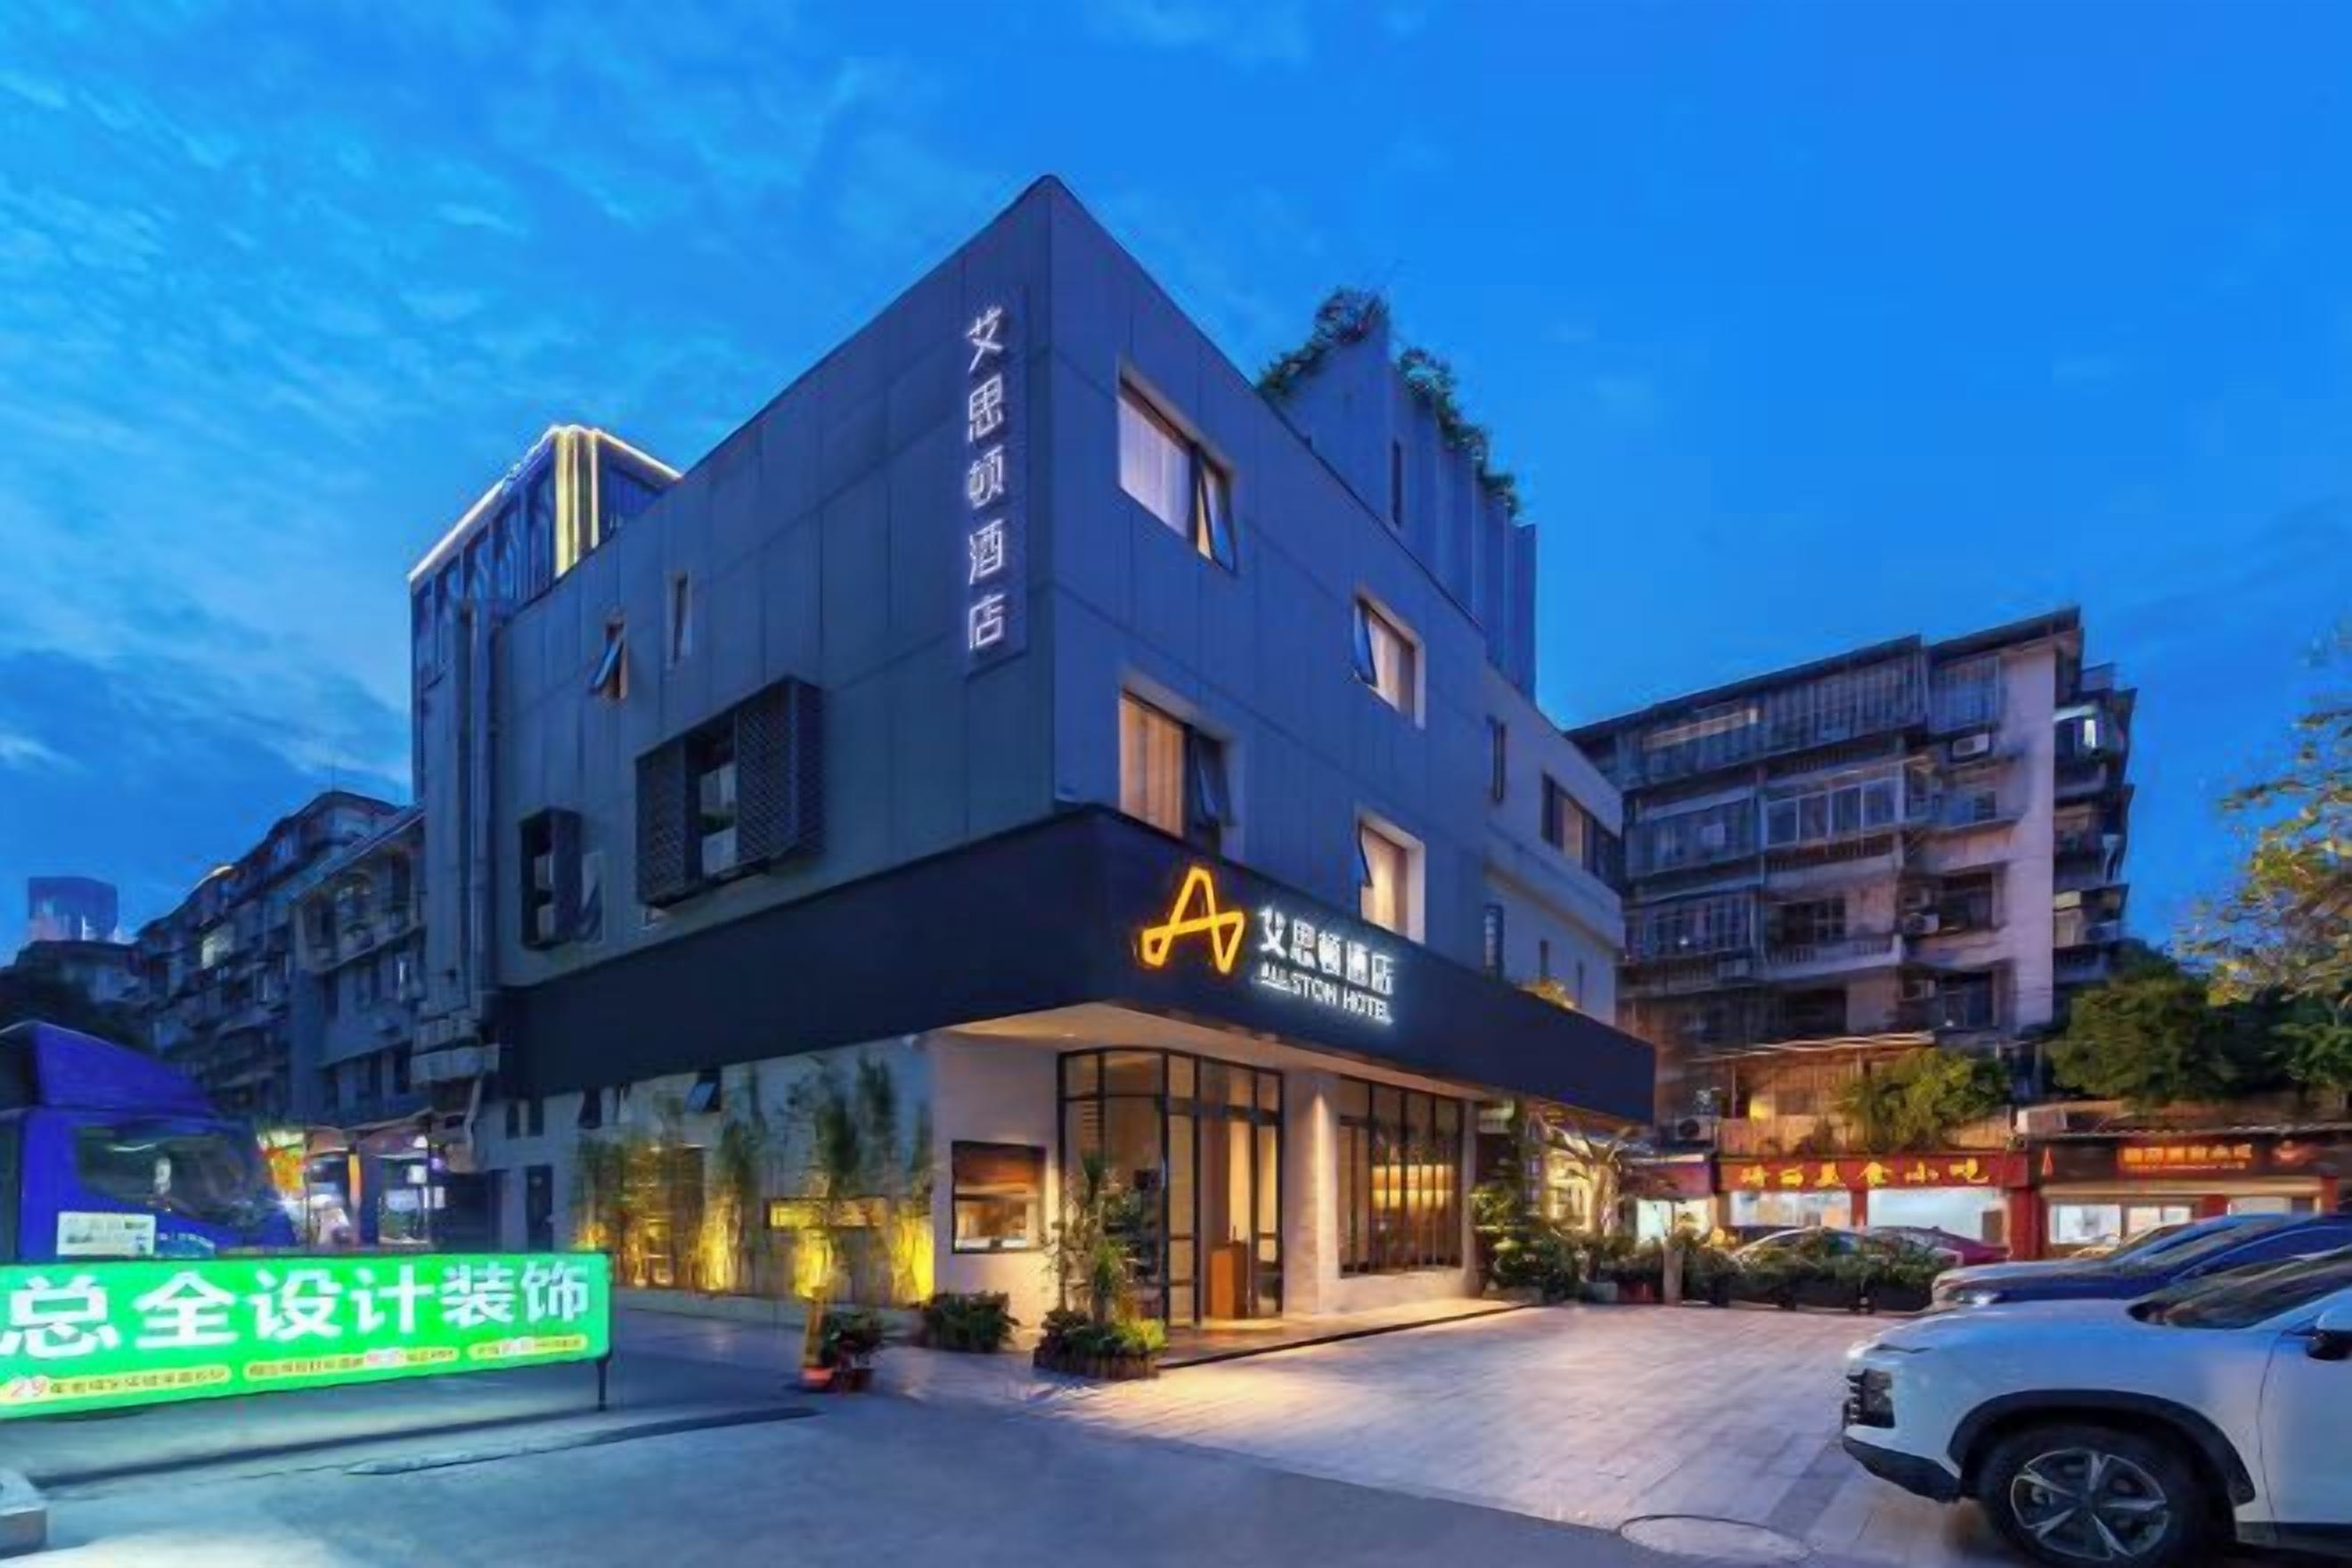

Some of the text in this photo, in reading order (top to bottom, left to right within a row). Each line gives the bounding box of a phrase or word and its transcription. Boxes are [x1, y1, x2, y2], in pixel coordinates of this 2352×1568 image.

[968, 306, 1005, 649] 艾思顿酒店
[0, 1261, 589, 1359] 总全设计装饰
